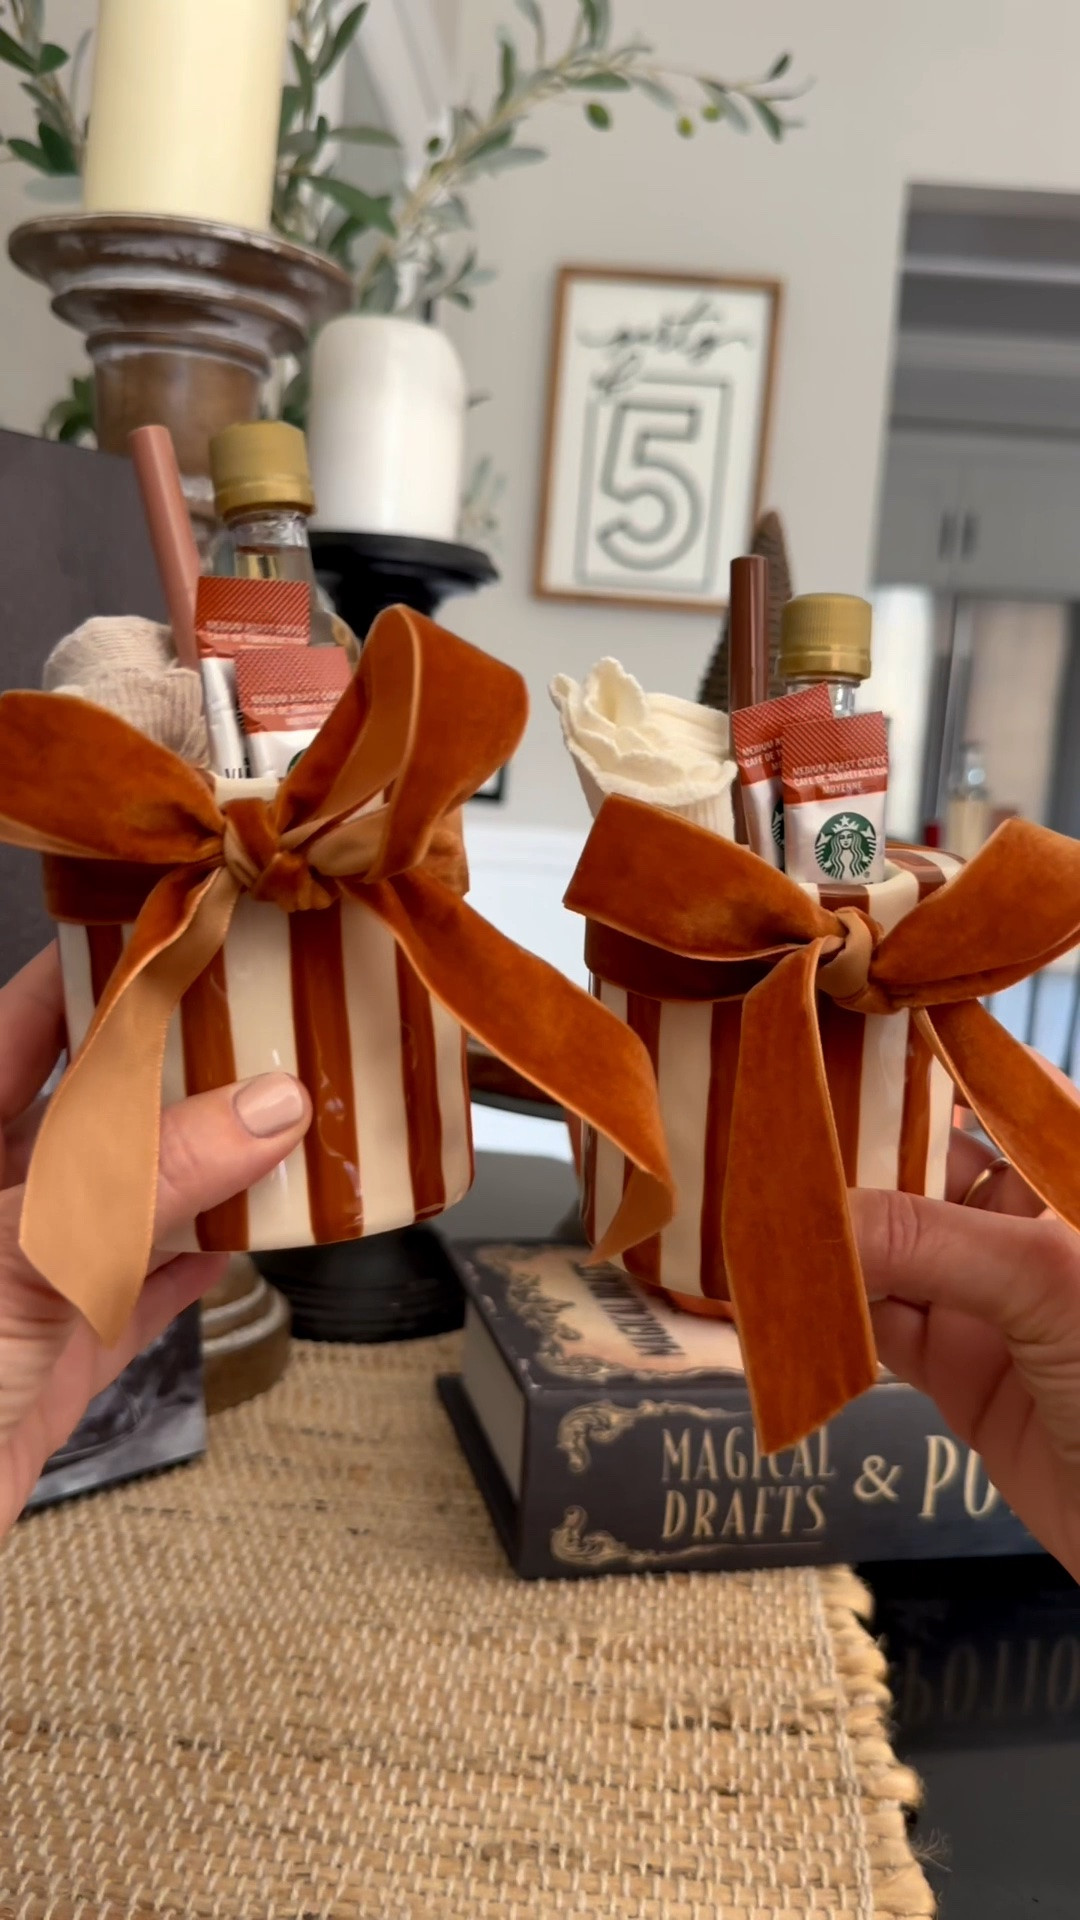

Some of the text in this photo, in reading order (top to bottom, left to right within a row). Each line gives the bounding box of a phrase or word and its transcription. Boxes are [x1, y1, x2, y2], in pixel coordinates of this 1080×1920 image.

[597, 396, 704, 572] 5
[661, 1484, 827, 1539] DRAFTS
[853, 1434, 1002, 1519] & PO
